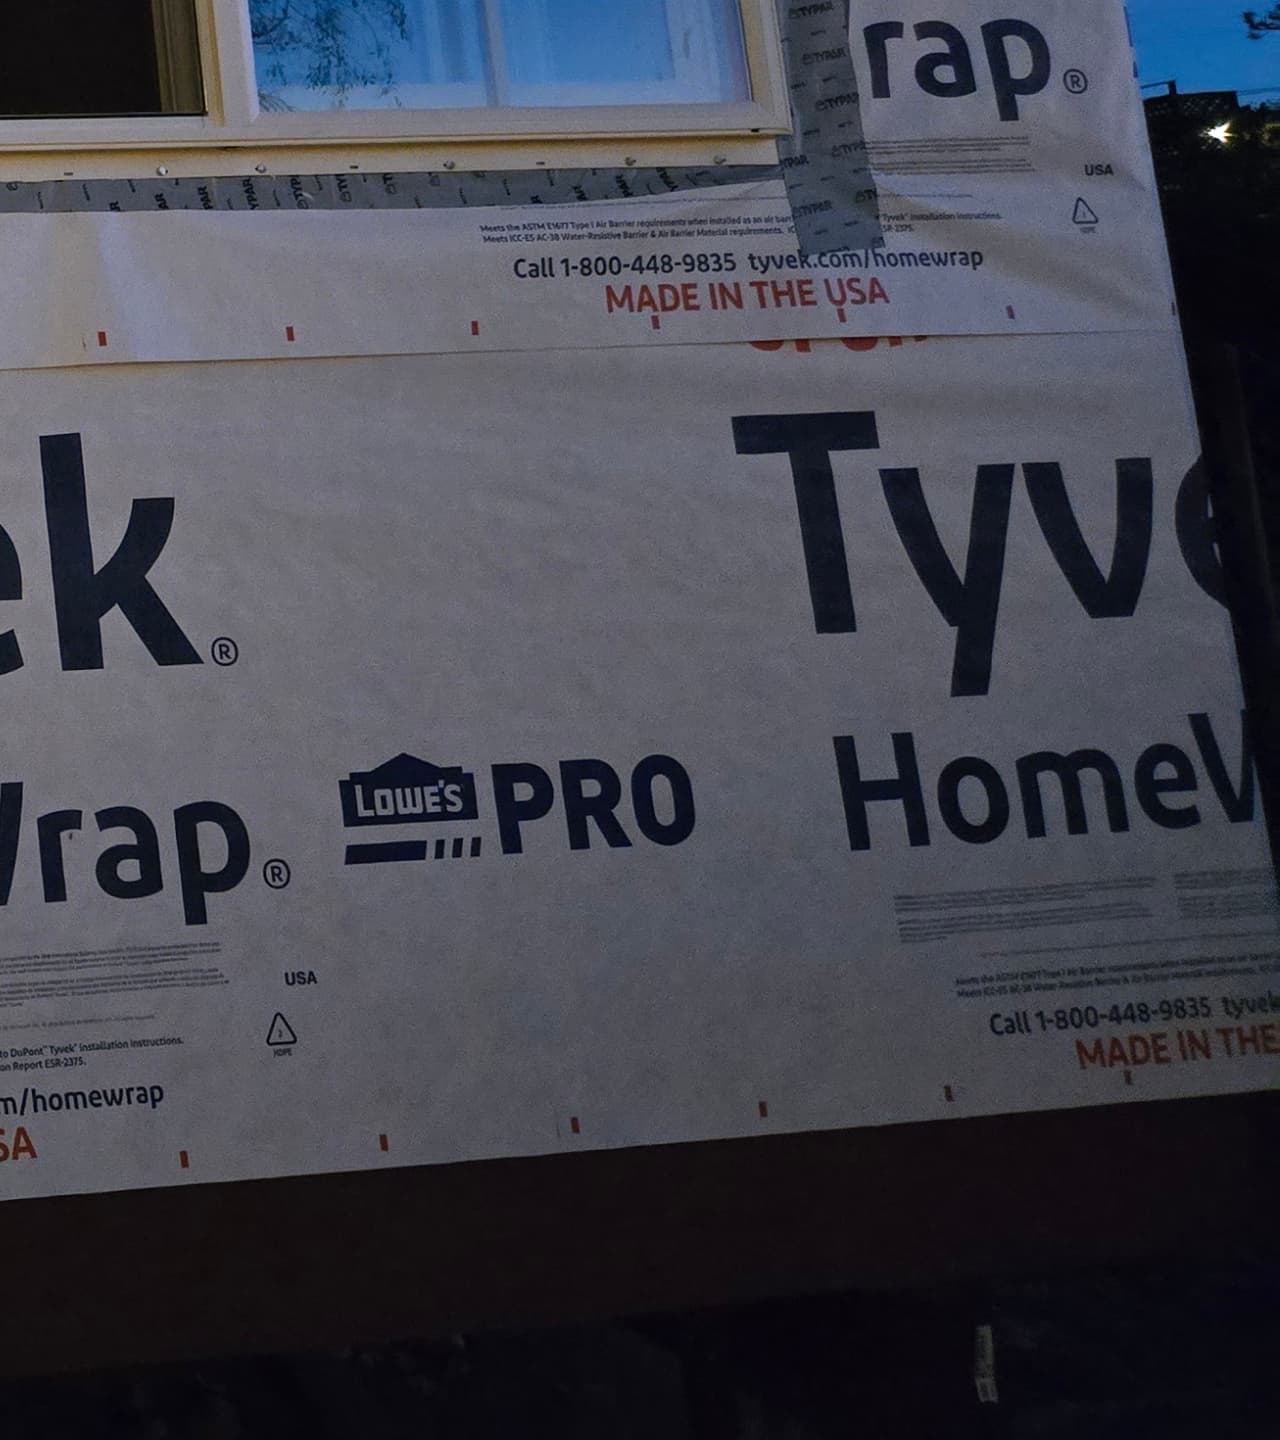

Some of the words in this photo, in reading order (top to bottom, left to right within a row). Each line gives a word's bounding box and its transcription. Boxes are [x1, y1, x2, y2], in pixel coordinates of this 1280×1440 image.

[1084, 163, 1114, 176] USA
[514, 258, 555, 278] Call
[560, 253, 736, 277] 1-800-448-9835
[605, 283, 700, 314] MADE
[708, 282, 744, 310] IN
[749, 279, 817, 308] THE
[824, 277, 890, 306] USA
[354, 778, 464, 818] LOWE'S
[491, 754, 696, 854] PRO
[285, 971, 318, 986] USA
[990, 1012, 1030, 1036] Call
[1038, 996, 1212, 1032] 1-800-448-9835
[0, 1051, 8, 1059] to
[1075, 1033, 1171, 1070] MADE
[1177, 1029, 1212, 1061] IN
[12, 1060, 44, 1073] Report
